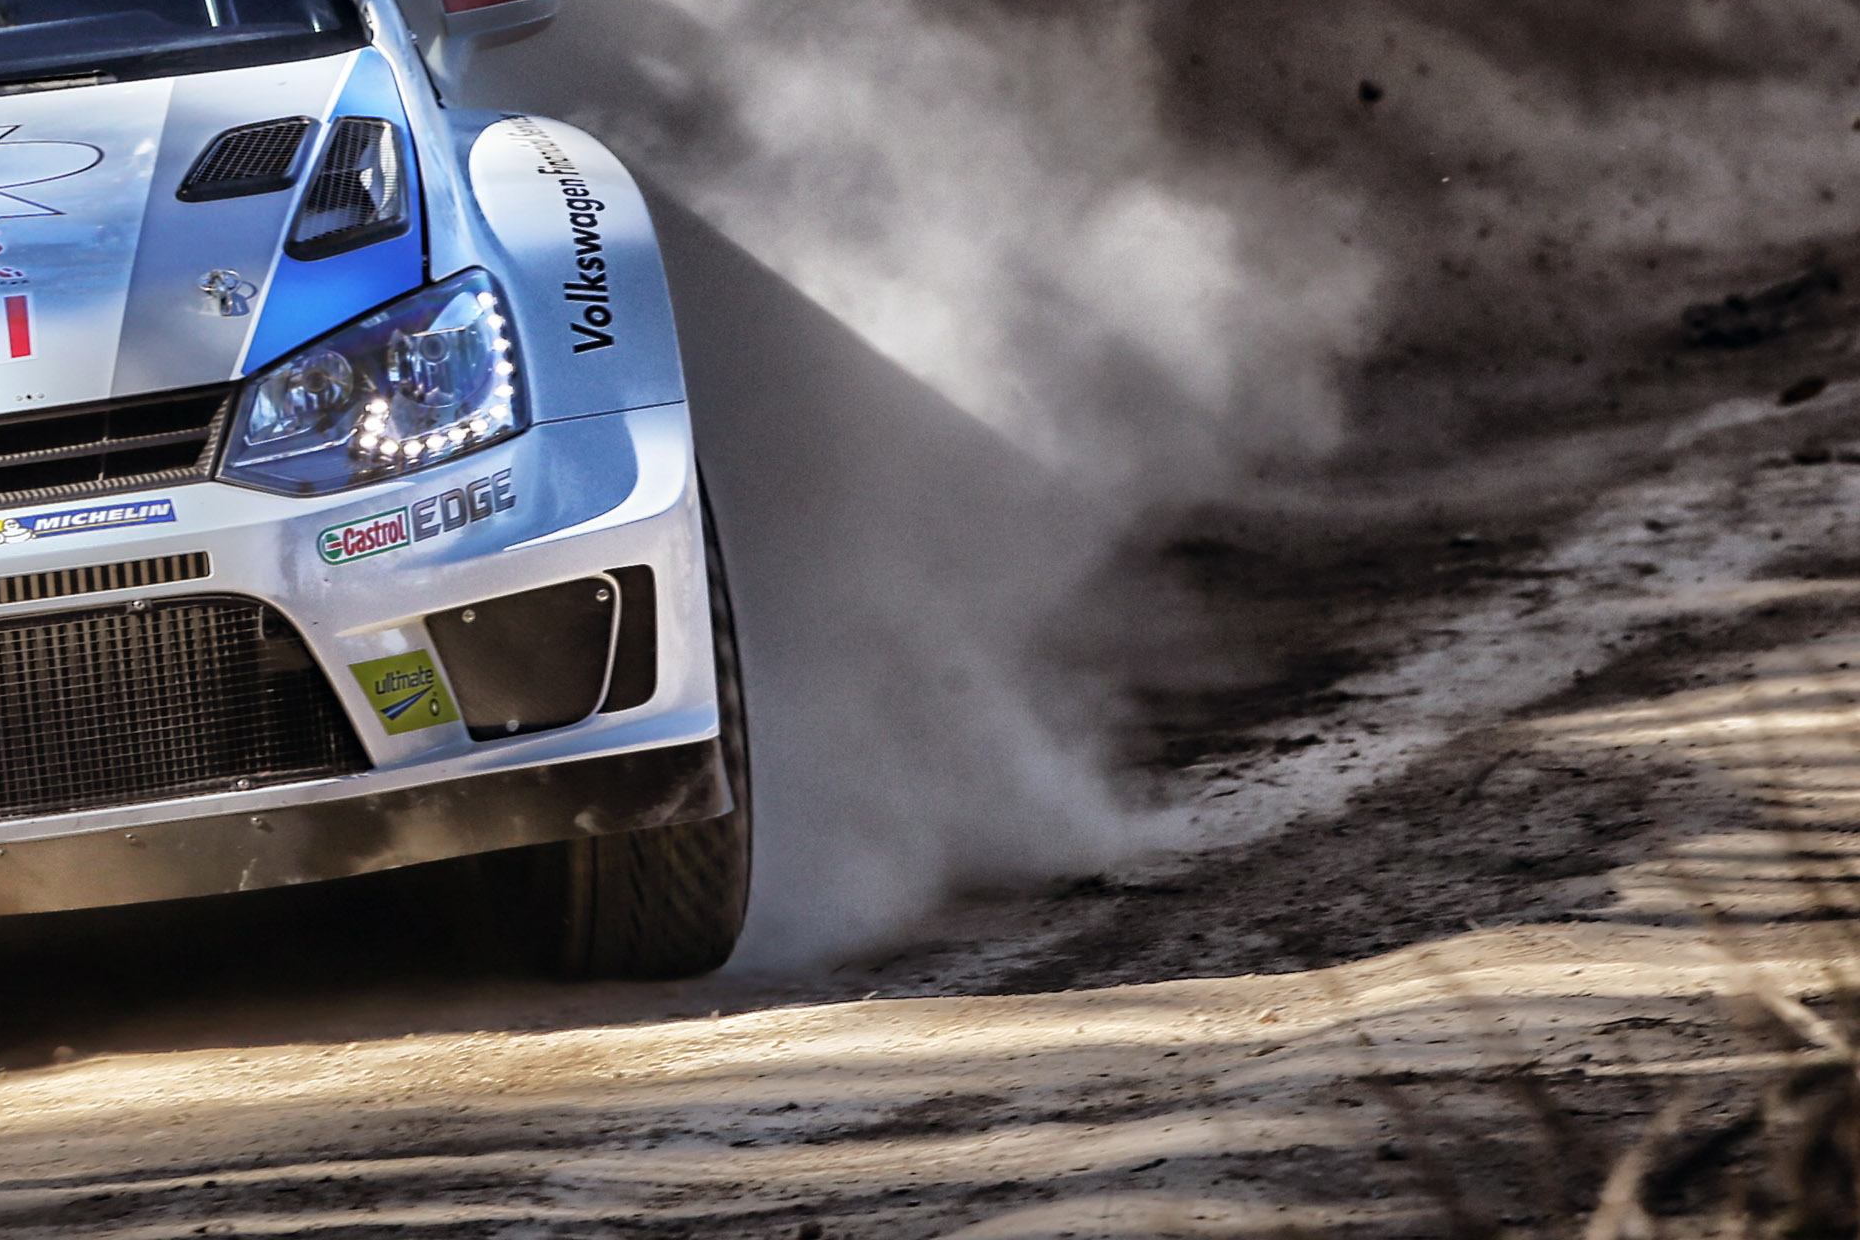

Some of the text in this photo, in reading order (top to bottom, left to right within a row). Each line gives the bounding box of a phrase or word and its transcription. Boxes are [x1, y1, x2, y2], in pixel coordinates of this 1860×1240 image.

[558, 177, 615, 355] Volkswagen
[33, 503, 171, 532] MICHELIN
[342, 466, 518, 557] Castrol EDGE
[374, 664, 435, 695] ultimate
